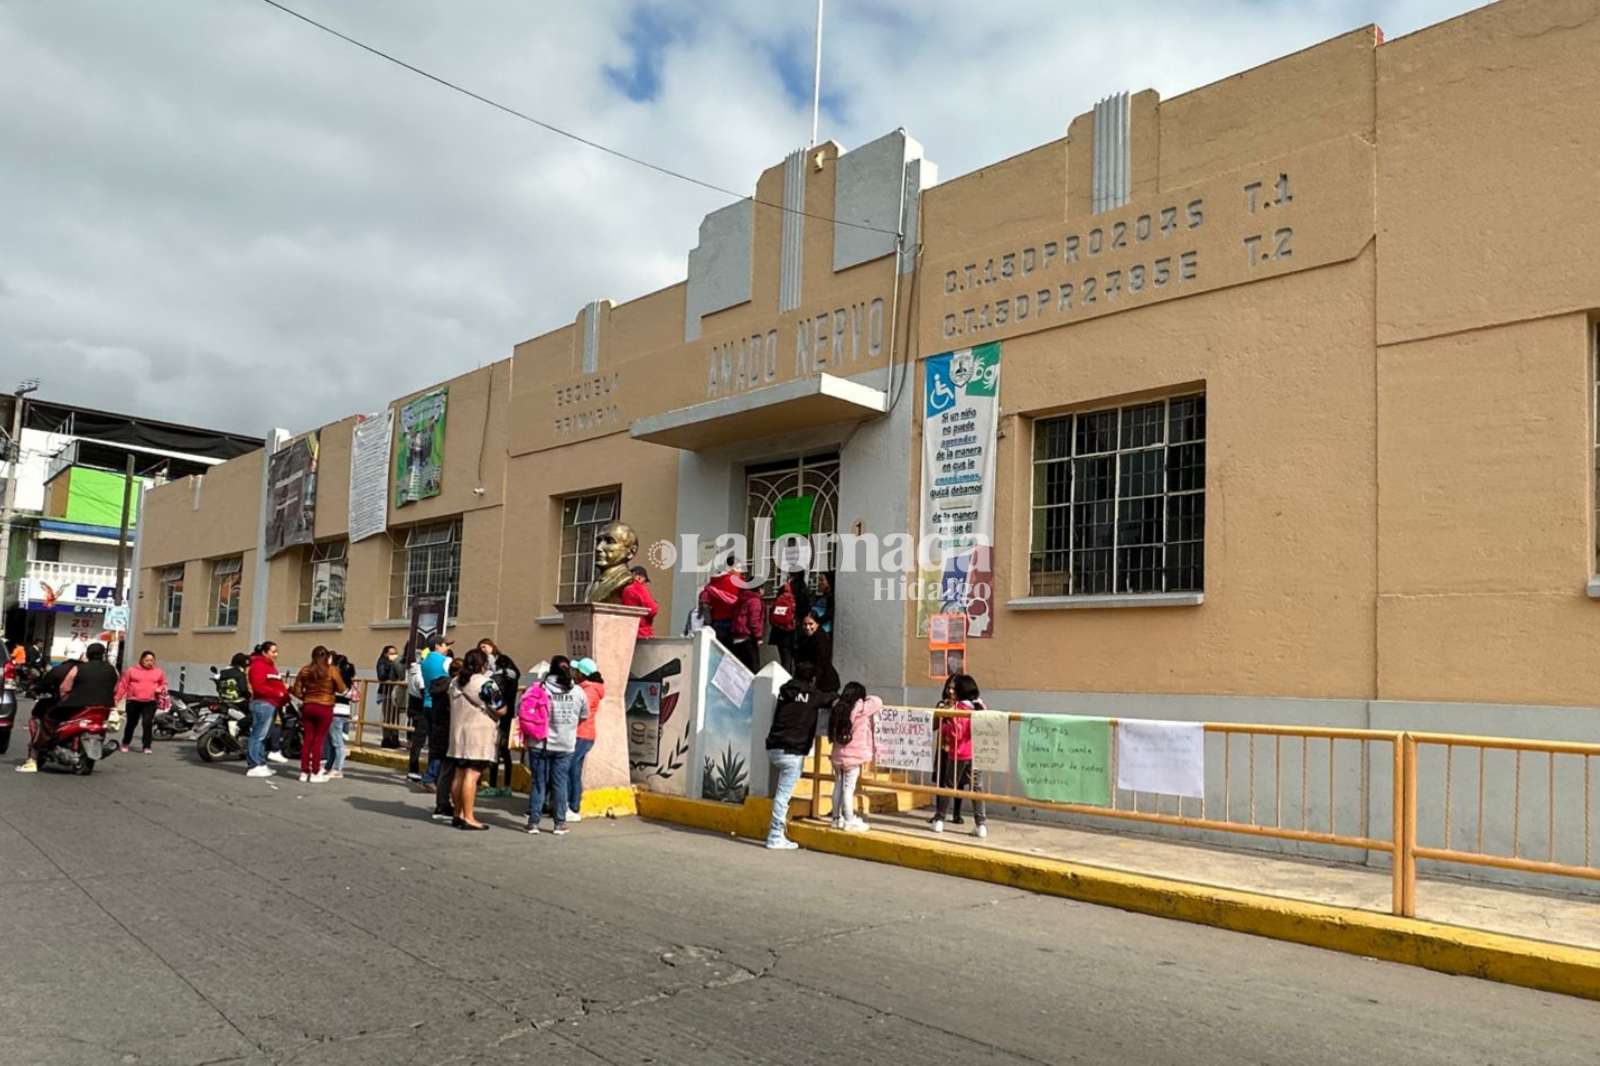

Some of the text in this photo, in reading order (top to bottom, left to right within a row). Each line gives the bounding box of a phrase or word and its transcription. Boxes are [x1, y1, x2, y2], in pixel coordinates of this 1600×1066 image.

[1244, 173, 1292, 214] T.1
[1244, 227, 1292, 266] T.2
[707, 297, 884, 397] AMADO NERVO
[950, 411, 959, 422] un
[960, 408, 977, 420] niño
[953, 421, 975, 436] puede
[936, 446, 982, 461] de la manera
[942, 459, 975, 474] en que le
[950, 484, 982, 497] debamos
[952, 511, 978, 523] manera
